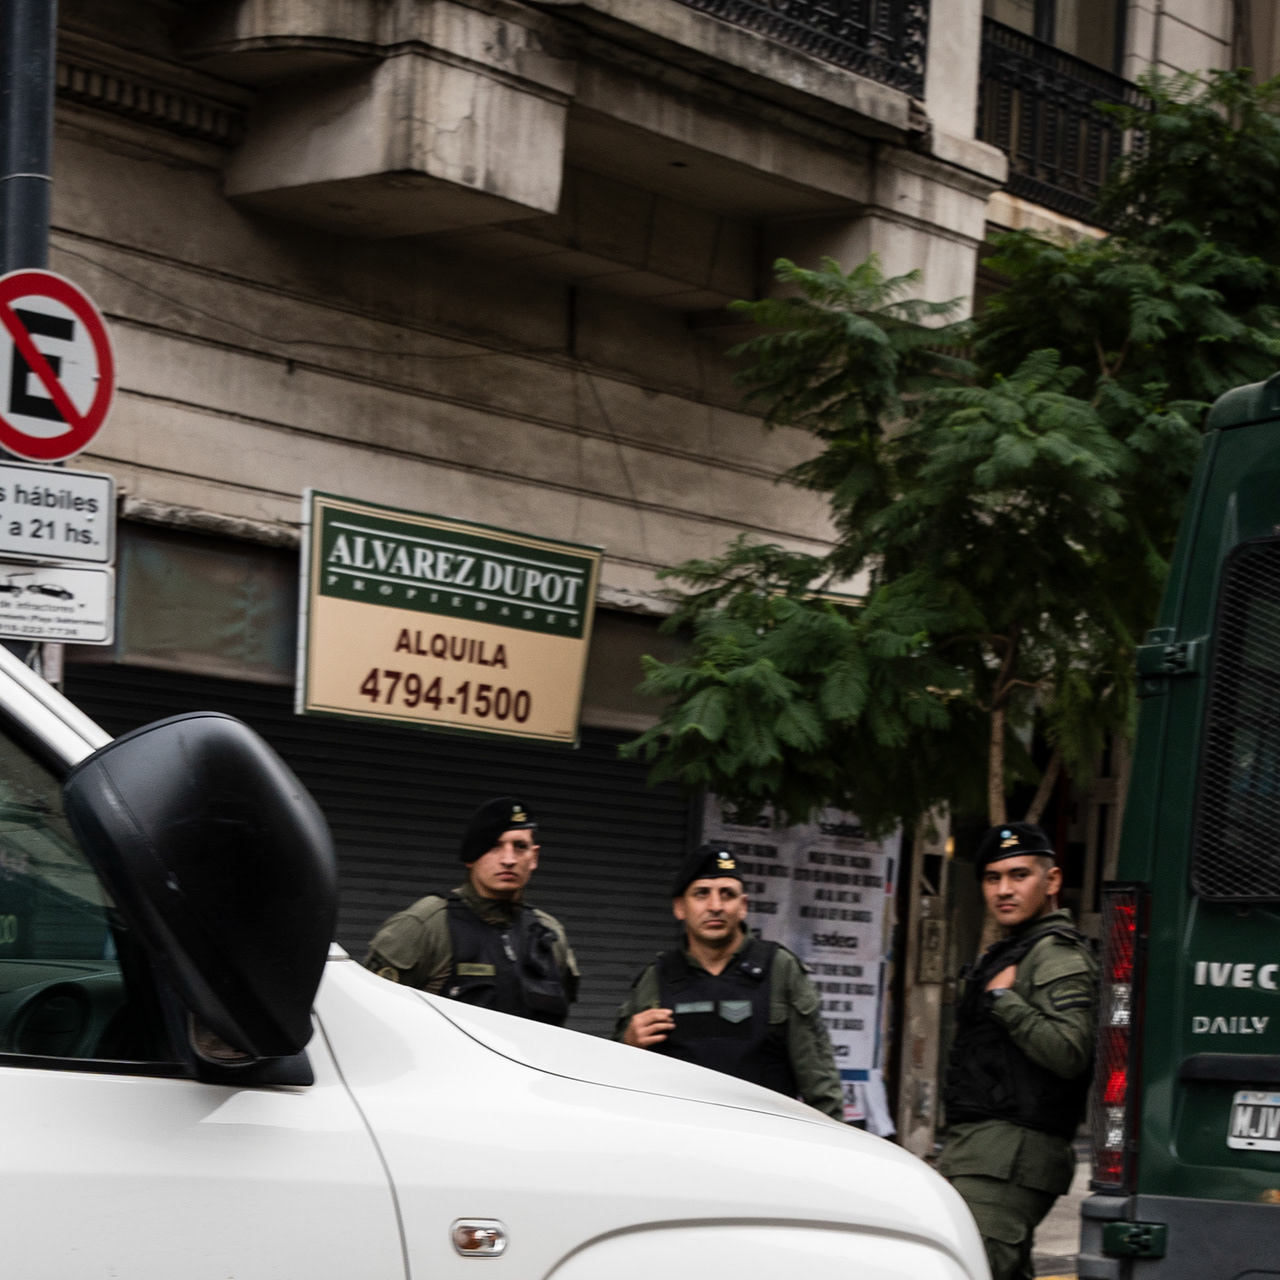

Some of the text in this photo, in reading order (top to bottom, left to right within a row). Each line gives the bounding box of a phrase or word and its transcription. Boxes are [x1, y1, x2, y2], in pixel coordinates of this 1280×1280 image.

[14, 483, 99, 514] hábiles
[8, 520, 23, 537] a
[30, 518, 56, 542] 21
[64, 523, 101, 546] hs.
[327, 533, 584, 606] ALVAREZ DUPOT
[394, 628, 509, 669] ALQUILA
[359, 667, 532, 724] 4794-1500
[1191, 1016, 1270, 1035] DAILY
